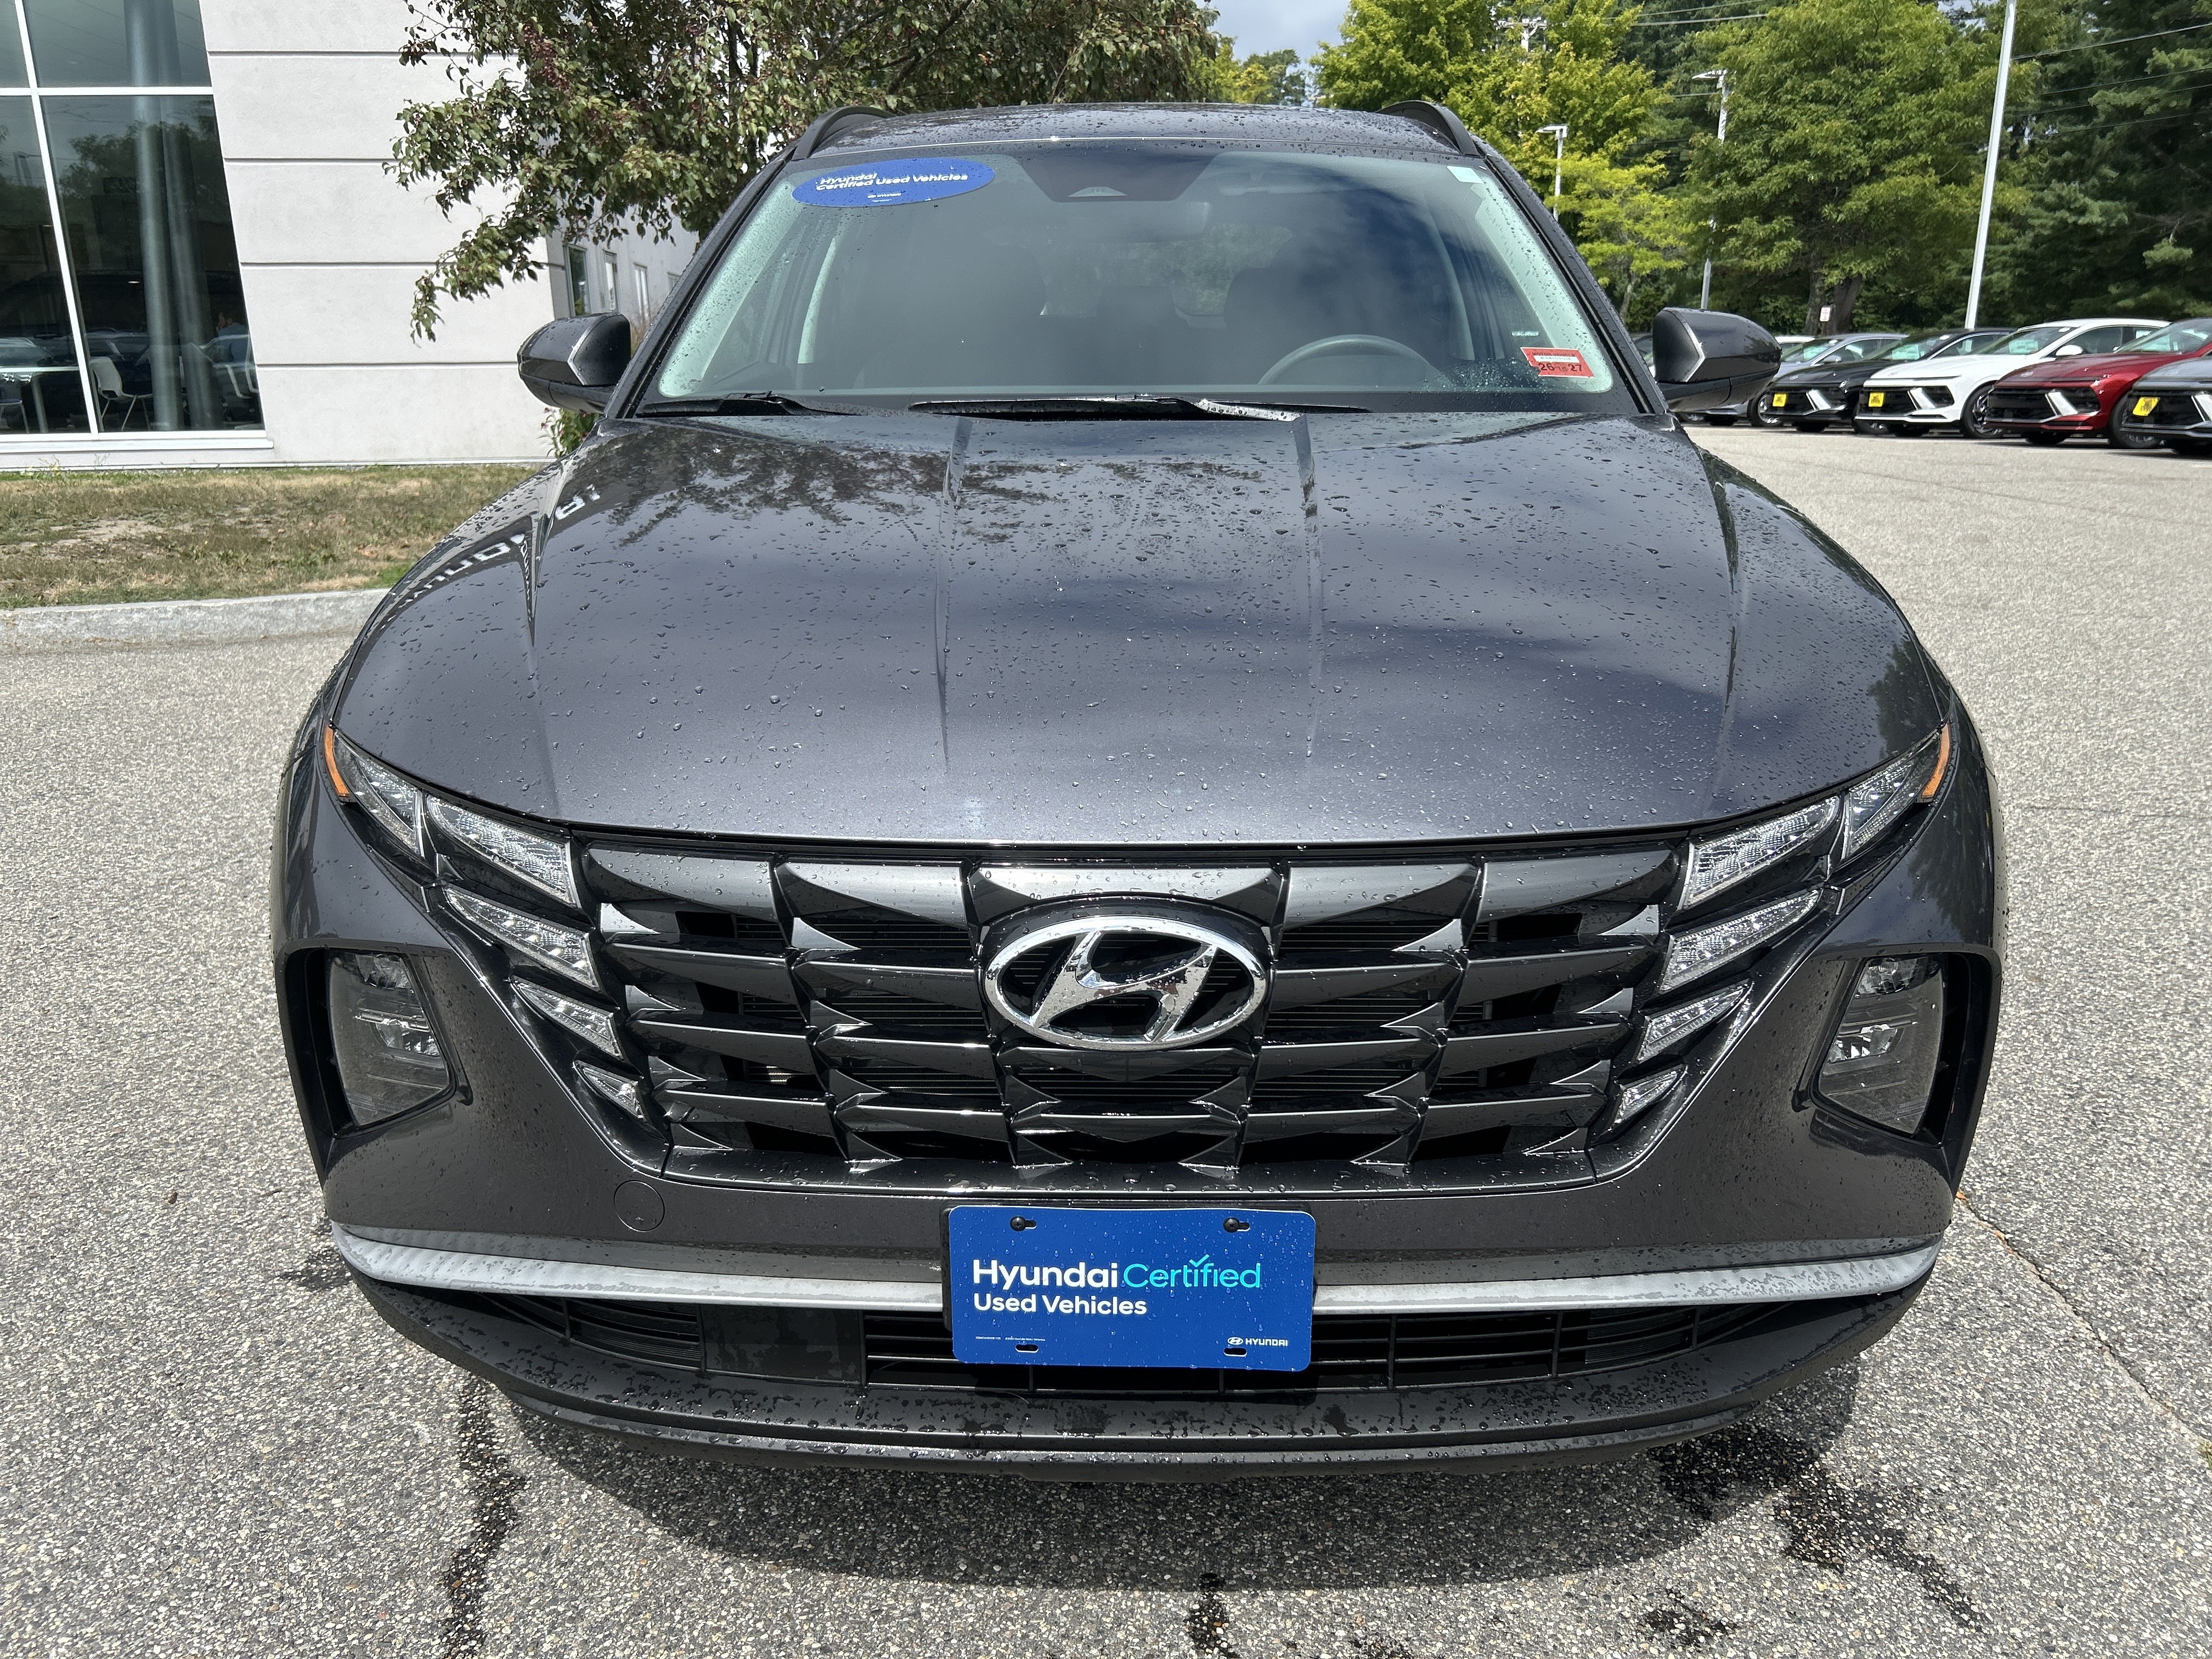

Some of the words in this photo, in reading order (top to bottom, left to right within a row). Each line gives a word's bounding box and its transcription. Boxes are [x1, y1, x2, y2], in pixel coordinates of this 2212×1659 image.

[816, 179, 874, 190] Certified
[875, 176, 911, 185] Used
[912, 174, 968, 182] Vehicles
[820, 173, 878, 185] Hyundai
[1538, 363, 1555, 371] 26
[1568, 364, 1582, 372] 27
[973, 1259, 1118, 1290] Hyundai
[1123, 1254, 1261, 1288] Certified
[974, 1293, 1037, 1313] Used
[1041, 1295, 1147, 1315] Vehicles
[1245, 1338, 1288, 1347] HYUNDAI
